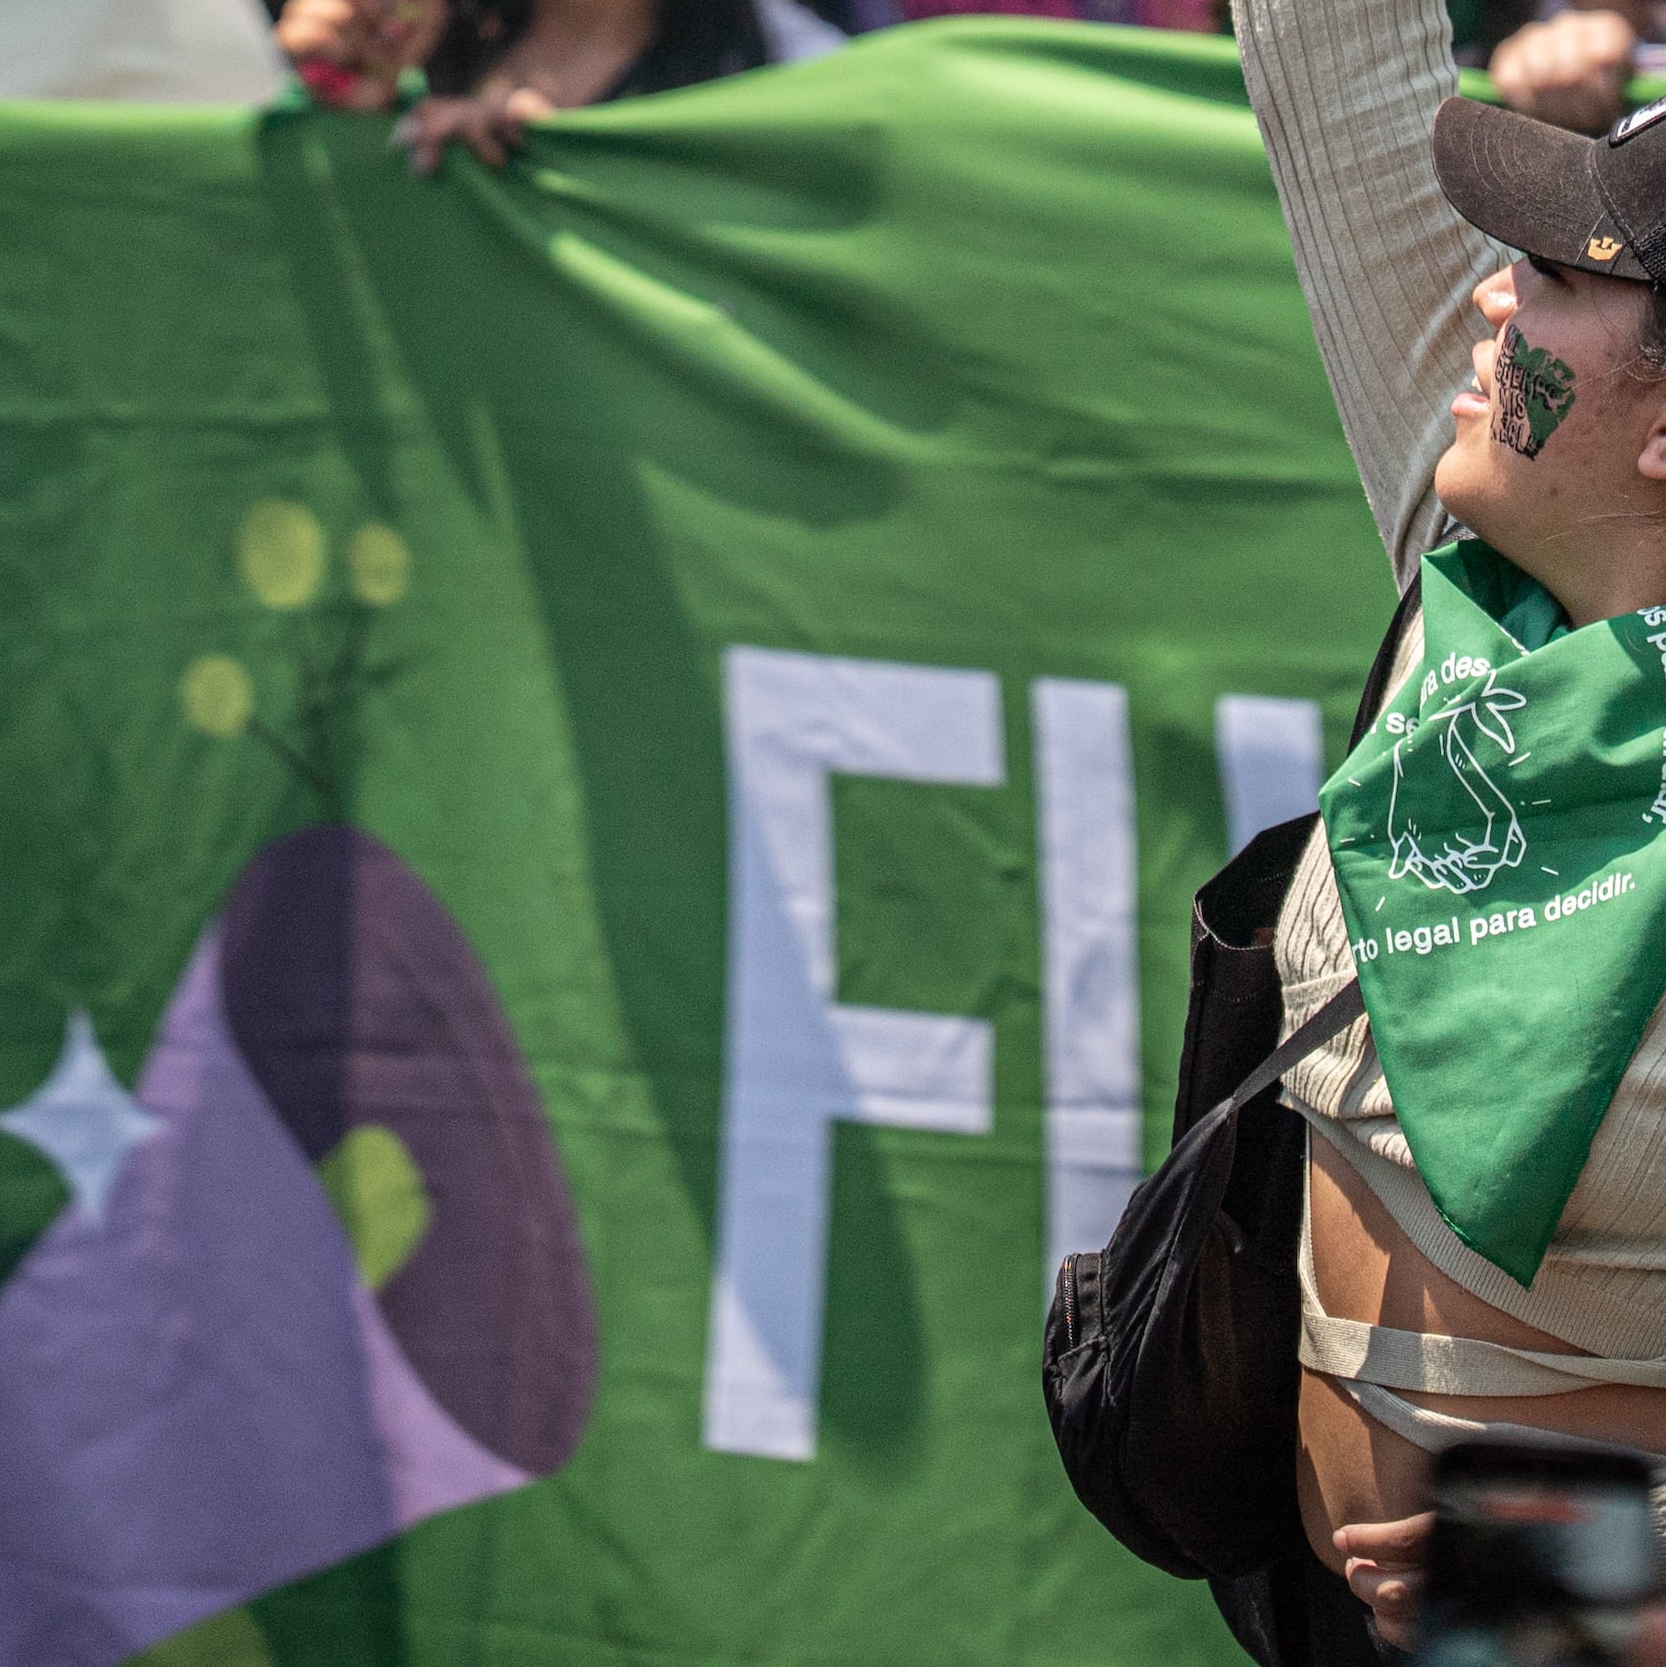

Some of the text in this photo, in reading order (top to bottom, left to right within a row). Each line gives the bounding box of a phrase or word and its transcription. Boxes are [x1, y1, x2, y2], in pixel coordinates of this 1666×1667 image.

[1386, 915, 1461, 955] legal
[1469, 906, 1537, 946] para
[1544, 871, 1637, 923] decidir.
